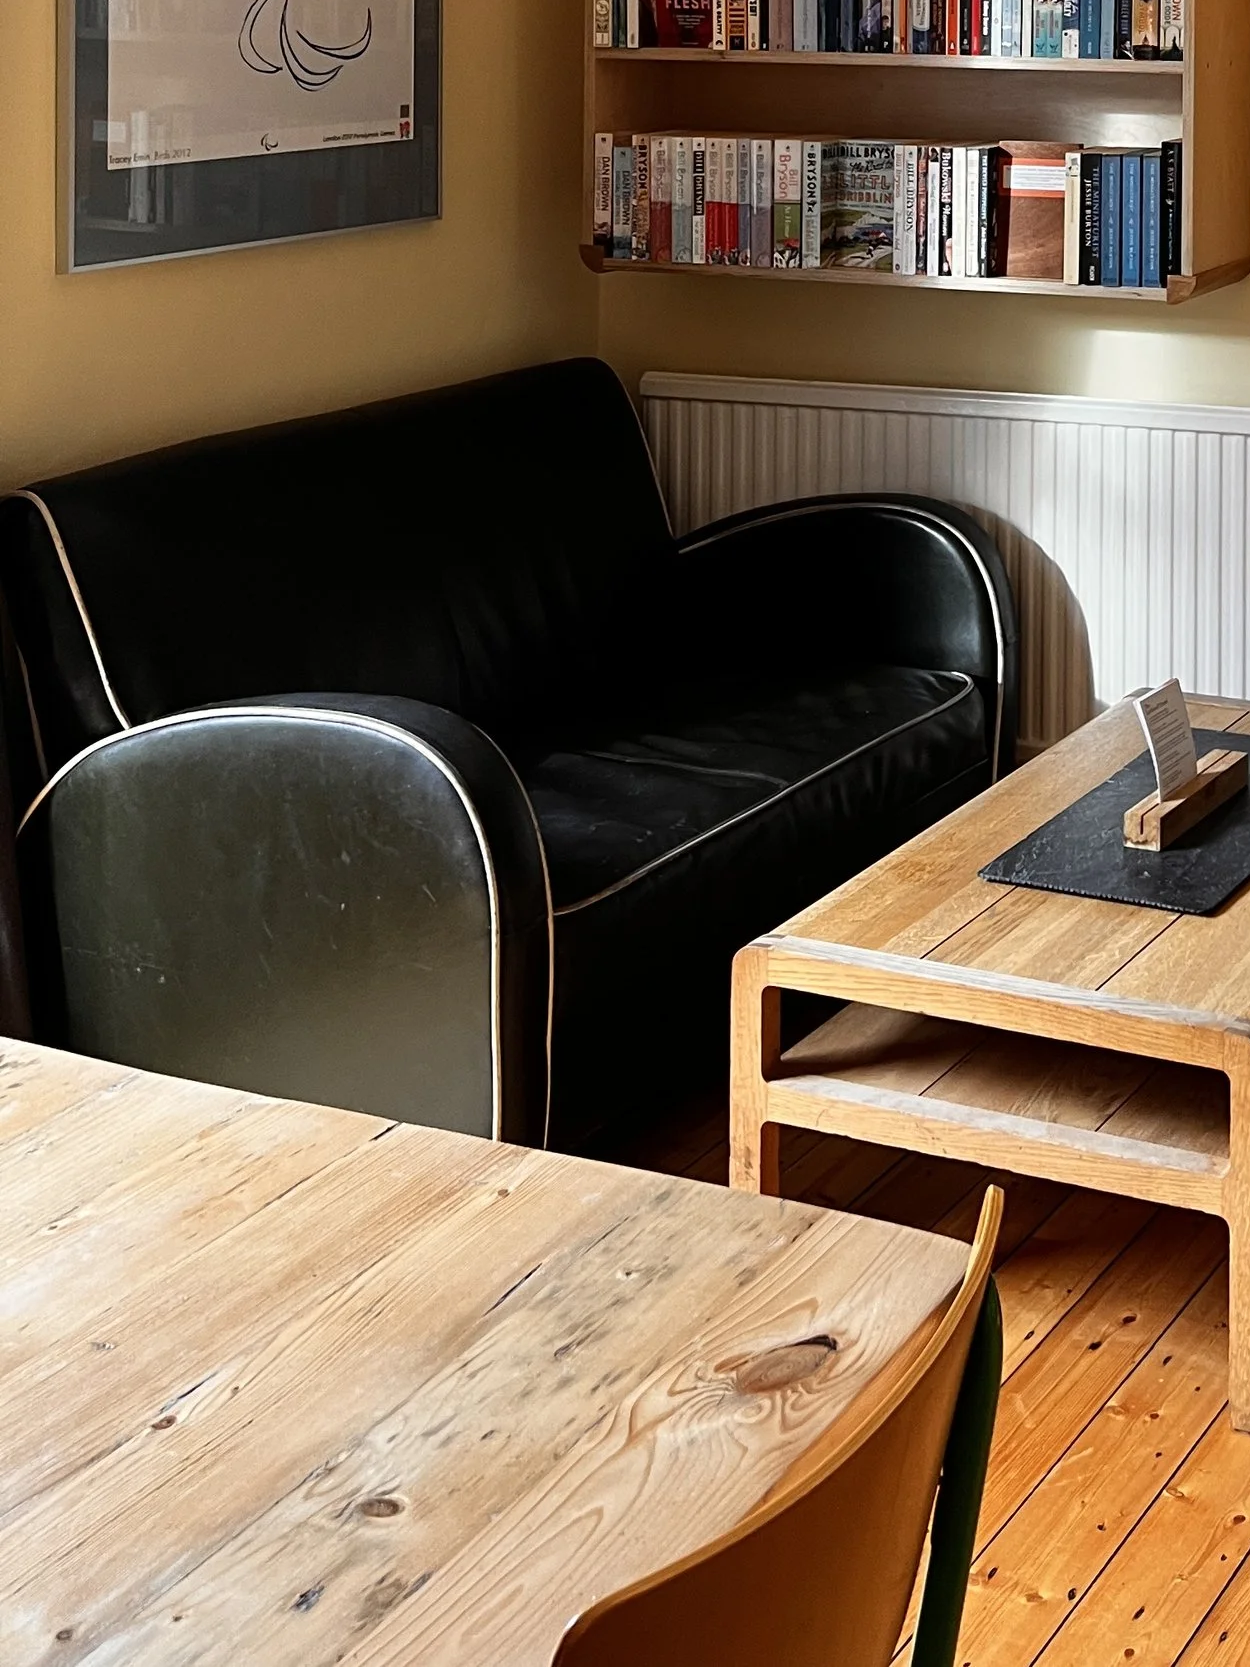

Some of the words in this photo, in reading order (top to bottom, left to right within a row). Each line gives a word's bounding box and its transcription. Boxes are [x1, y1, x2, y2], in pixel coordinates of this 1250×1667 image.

[602, 155, 611, 176] DAN
[638, 144, 648, 190] BRYSON
[706, 151, 717, 166] Bill
[906, 162, 915, 186] BILL
[622, 170, 631, 190] DAN
[675, 168, 685, 200] Bryson
[706, 168, 717, 199] Bryson
[778, 154, 792, 198] Bryson
[789, 169, 798, 187] Bill
[806, 152, 817, 198] BRYSON
[838, 173, 891, 190] LITTL
[940, 151, 951, 203] Bukowski
[602, 177, 611, 211] BROWN
[838, 191, 893, 204] DRIBBLIN
[1084, 178, 1092, 207] JESSIE
[622, 191, 631, 226] BROWN
[906, 187, 915, 232] BRYSON
[1084, 209, 1092, 248] BURTON
